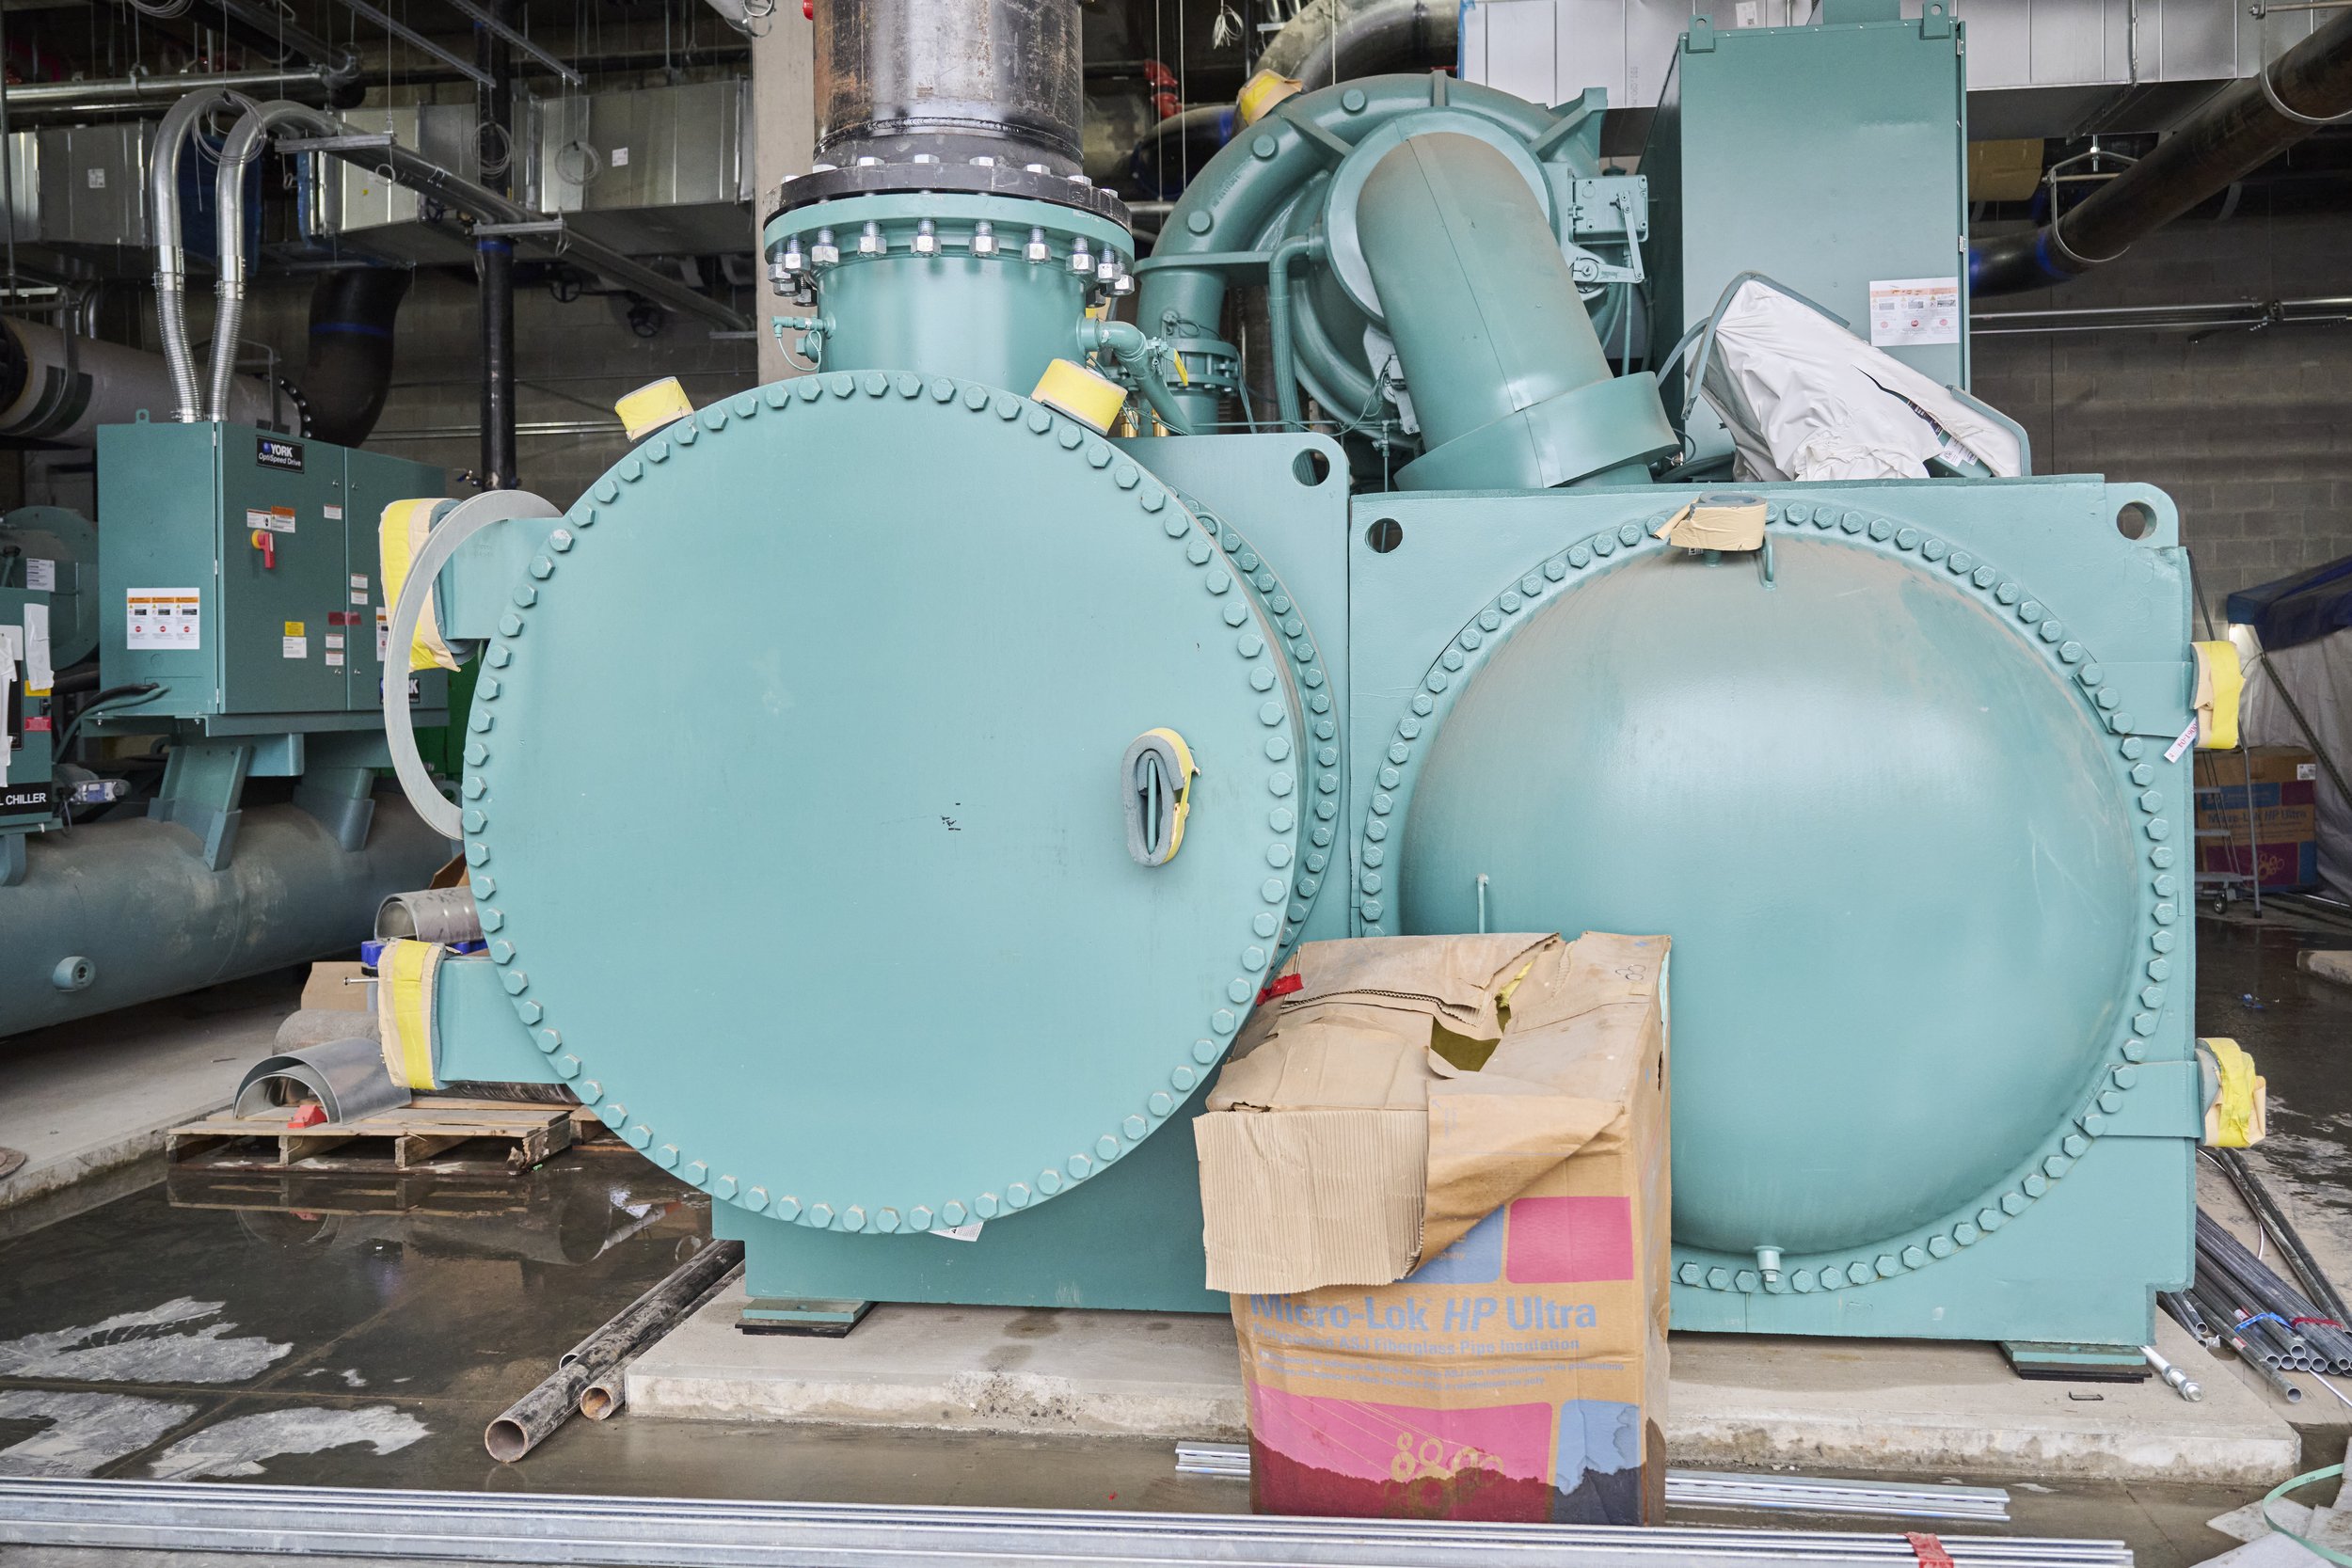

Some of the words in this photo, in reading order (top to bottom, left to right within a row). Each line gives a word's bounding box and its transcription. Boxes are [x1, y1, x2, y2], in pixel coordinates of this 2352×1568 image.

[270, 443, 293, 457] YORK
[259, 452, 286, 464] OptiSpeed
[287, 457, 301, 467] Drive
[6, 792, 46, 805] CHILLER
[1250, 1293, 1429, 1332] Micro-Lok
[1442, 1296, 1499, 1332] HP
[1506, 1295, 1597, 1330] Ultra
[1340, 1336, 1370, 1351] ASJ
[1375, 1338, 1455, 1357] Fiberglass
[1460, 1338, 1495, 1356] Pipe
[1501, 1338, 1580, 1354] Insulation
